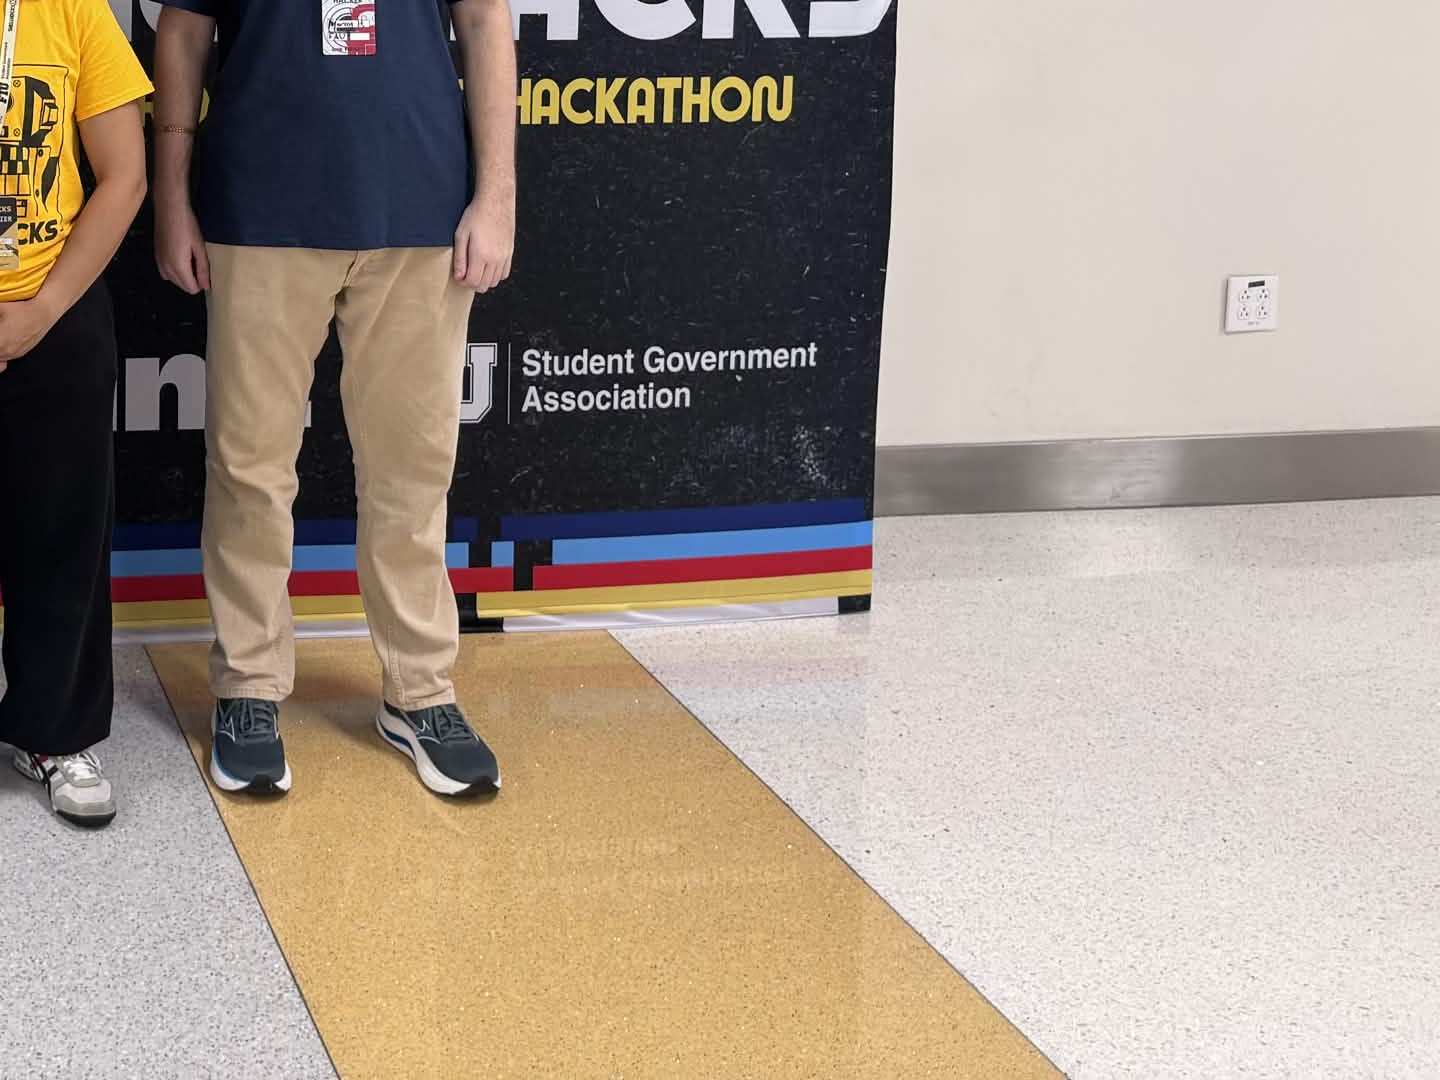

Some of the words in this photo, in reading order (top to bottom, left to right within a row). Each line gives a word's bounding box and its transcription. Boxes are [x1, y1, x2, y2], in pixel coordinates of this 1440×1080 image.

[516, 75, 794, 125] HACKATHON
[521, 348, 635, 376] Student
[643, 342, 819, 373] Government
[521, 382, 692, 412] Association
